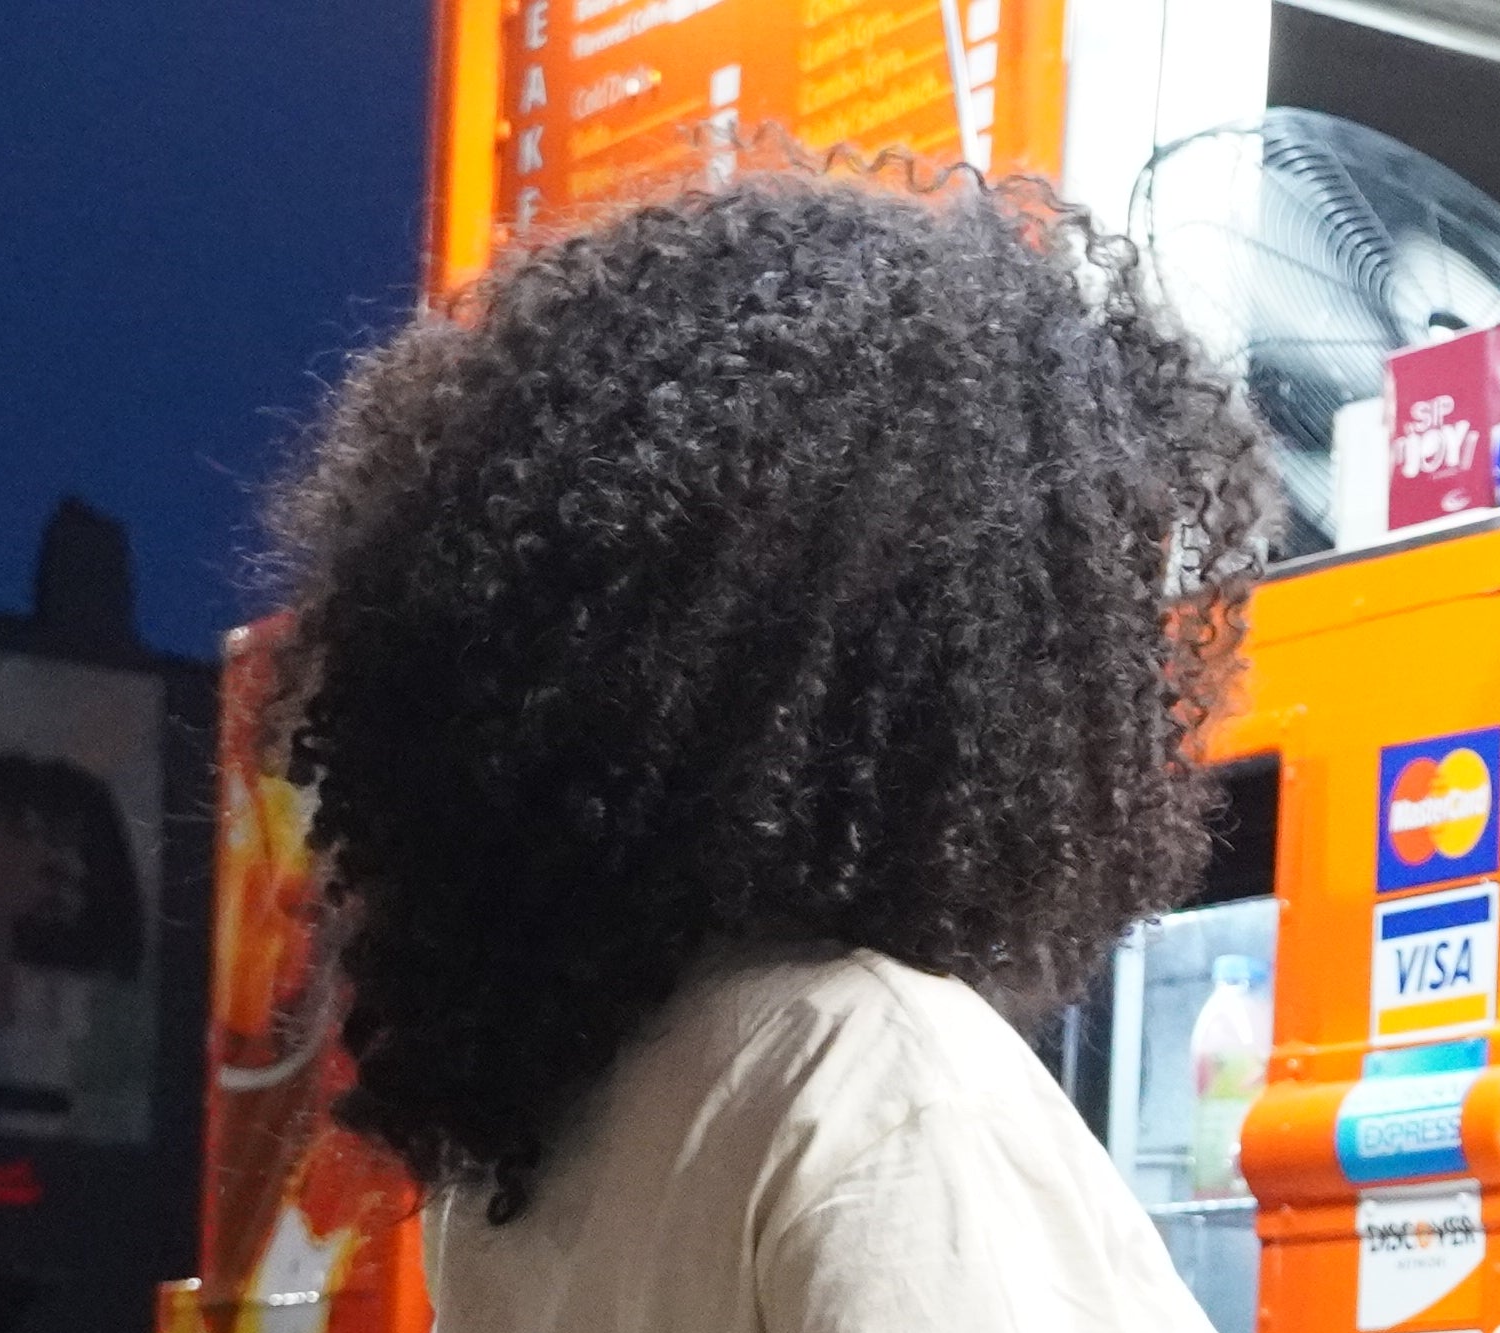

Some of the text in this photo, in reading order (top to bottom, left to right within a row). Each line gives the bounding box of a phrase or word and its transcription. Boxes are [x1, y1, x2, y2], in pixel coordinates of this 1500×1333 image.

[1396, 935, 1474, 994] VISA
[1362, 1115, 1461, 1150] EXPRESS
[1367, 1215, 1477, 1253] DISCOVER
